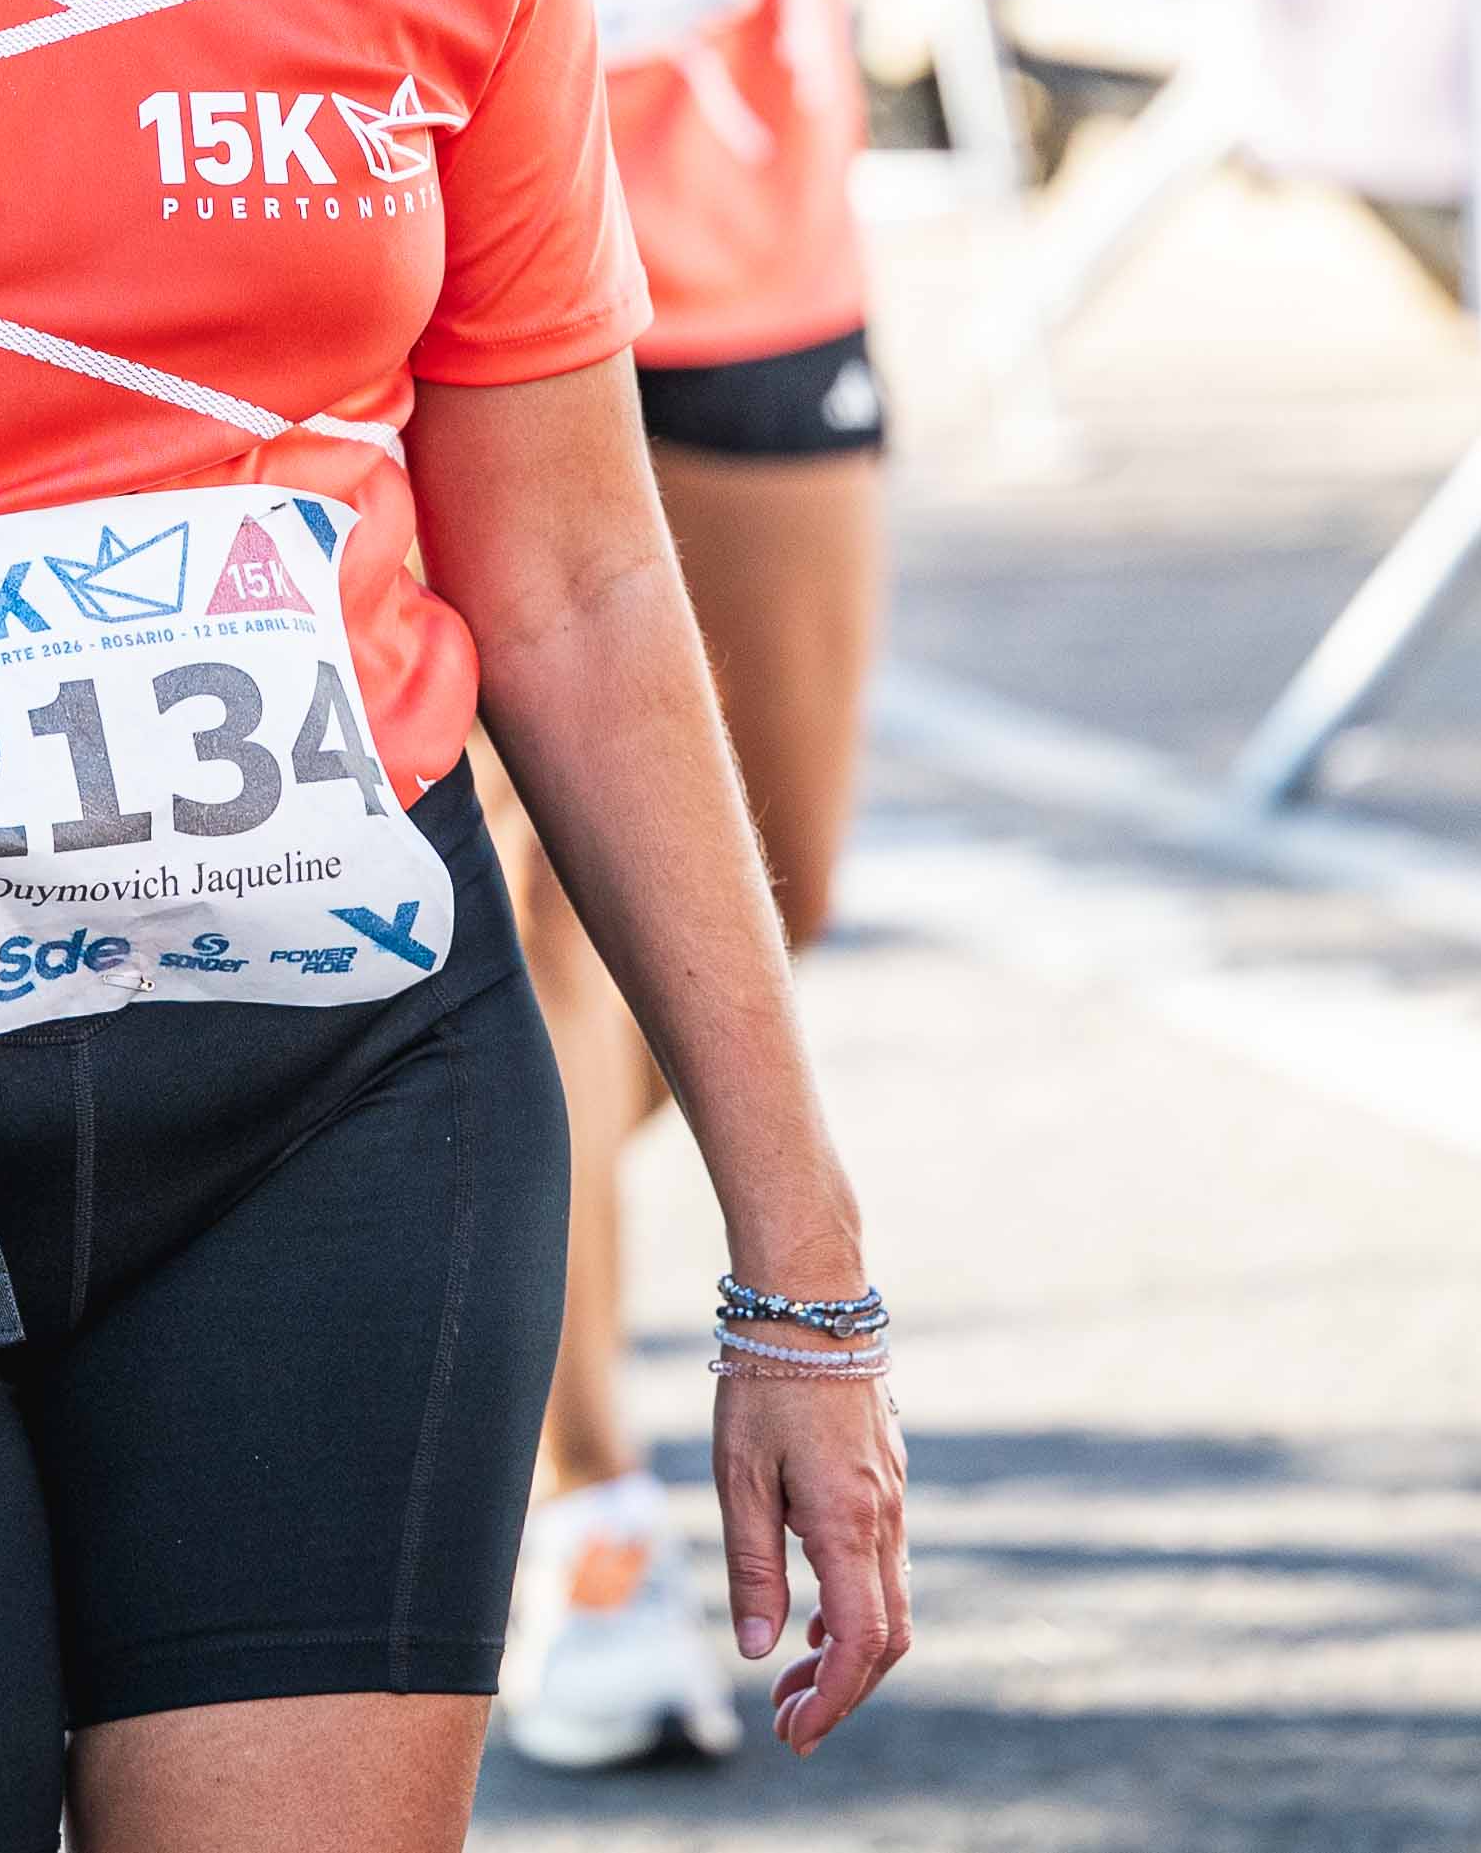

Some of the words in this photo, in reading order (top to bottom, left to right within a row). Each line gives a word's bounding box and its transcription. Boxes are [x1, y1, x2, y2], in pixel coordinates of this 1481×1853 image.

[138, 91, 338, 186] 15K
[162, 196, 341, 220] PUERTO
[357, 181, 437, 219] NORTE
[42, 639, 83, 658] 2026
[101, 627, 175, 650] ROSARIO
[193, 624, 212, 638] 12
[218, 620, 239, 635] DE
[245, 617, 290, 634] ABRIL
[191, 850, 342, 898] Jaqueline
[269, 946, 358, 964] POWER
